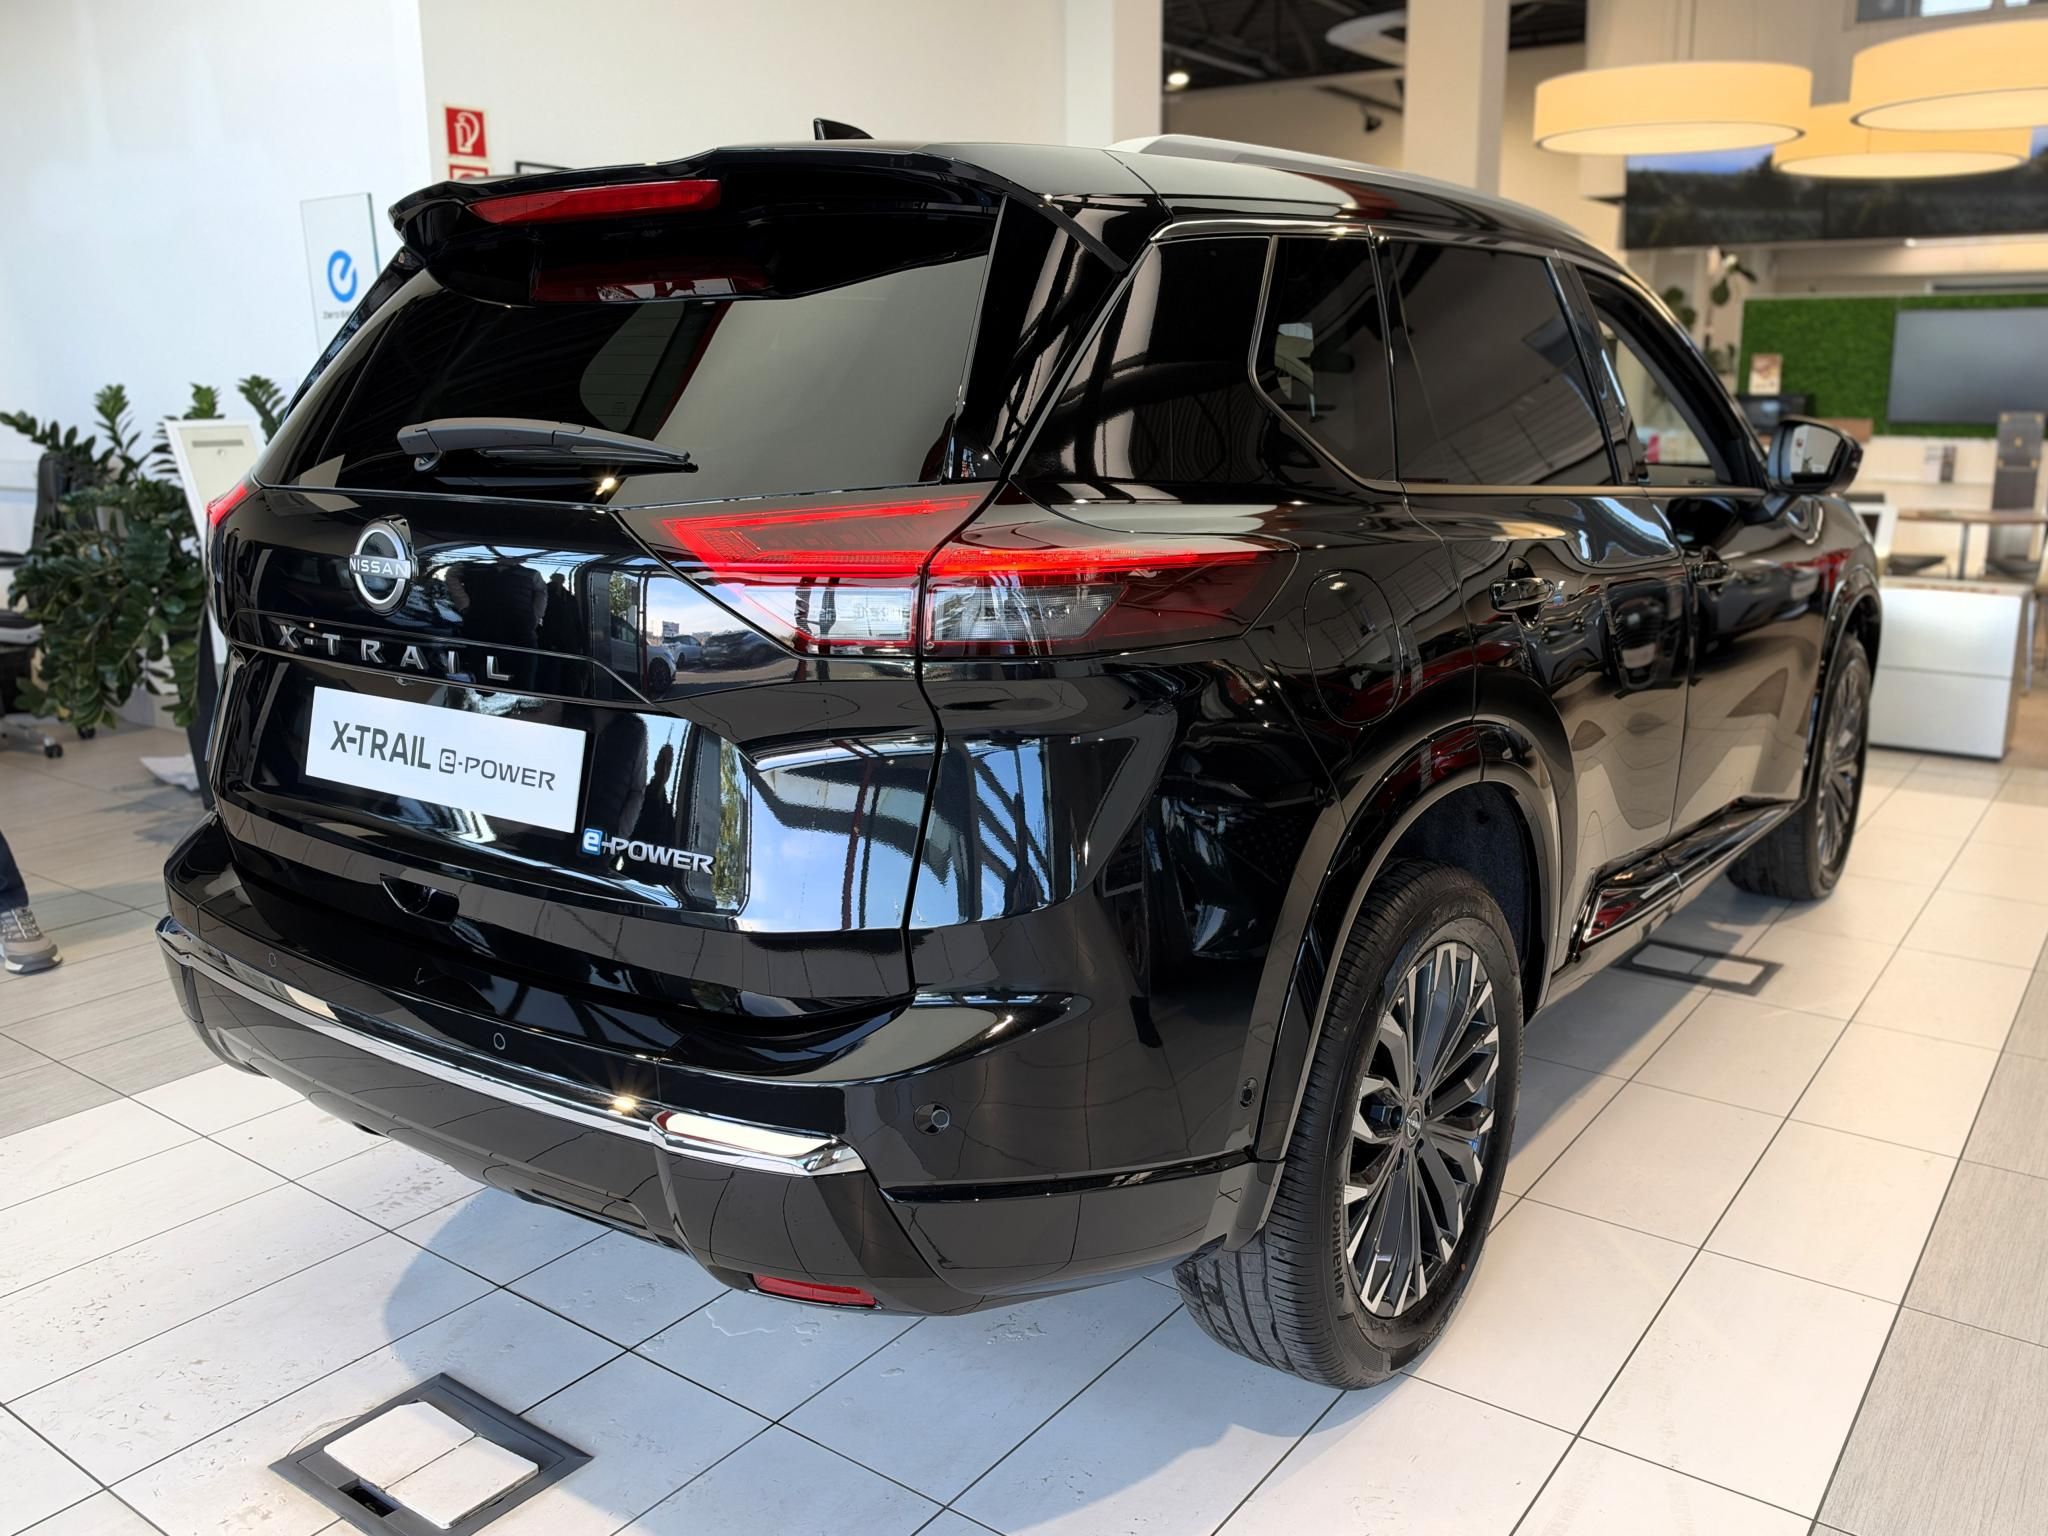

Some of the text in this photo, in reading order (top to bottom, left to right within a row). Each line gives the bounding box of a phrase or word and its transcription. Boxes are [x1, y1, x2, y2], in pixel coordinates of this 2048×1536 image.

[349, 557, 409, 576] NISSAN
[279, 624, 512, 682] X-TRAIL
[330, 720, 556, 791] X-TRAIL e-POWER
[582, 828, 714, 875] e-POWER
